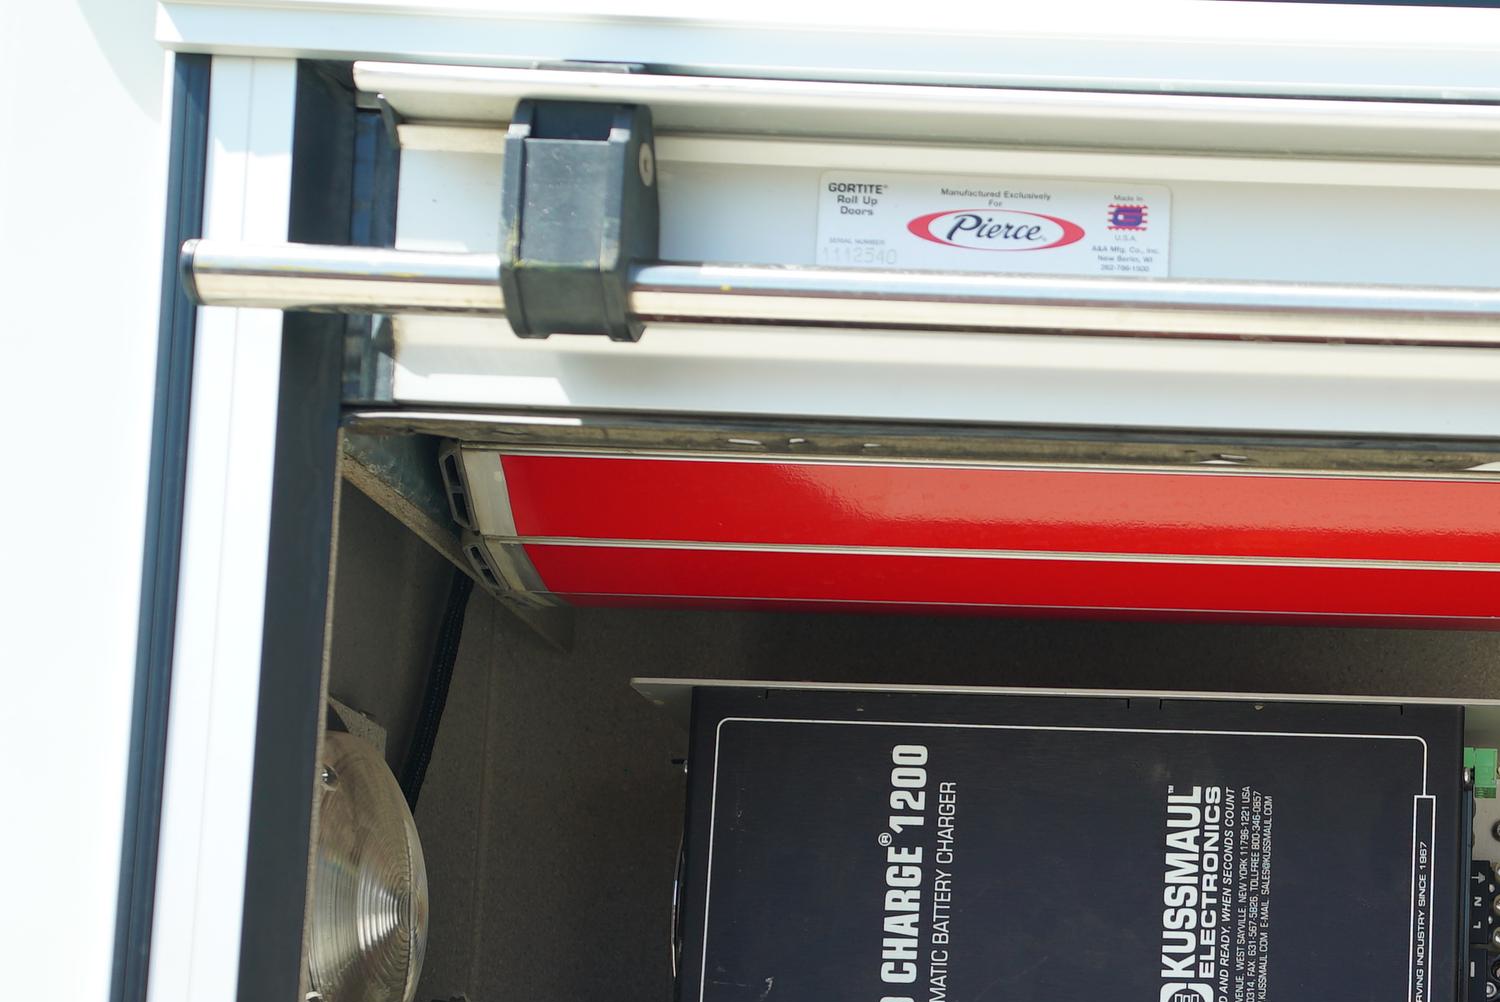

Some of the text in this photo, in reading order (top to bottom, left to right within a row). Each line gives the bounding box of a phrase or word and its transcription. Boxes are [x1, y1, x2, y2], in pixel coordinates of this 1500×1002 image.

[837, 194, 878, 207] Roll Up
[840, 205, 874, 216] Doors
[941, 188, 1051, 201] Manufactured Exclusively
[988, 199, 1002, 207] For
[946, 213, 1042, 241] Pierce
[889, 743, 929, 833] 1200
[1241, 786, 1250, 803] USA
[935, 781, 957, 864] CHARGER
[1225, 786, 1235, 827] COUNT
[1252, 790, 1262, 850] 800-346-0857
[1240, 806, 1250, 855] 11796-1221
[1262, 796, 1273, 895] SALES@KUSSMAUL.COM
[1222, 830, 1233, 885] SECONDS
[1239, 858, 1248, 880] YORK
[1250, 852, 1260, 892] TOLLFREE
[1199, 786, 1221, 978] ELECTRONICS
[1238, 882, 1248, 902] NEW
[1417, 874, 1428, 906] SINCE
[931, 868, 952, 944] BATTERY
[1222, 887, 1232, 922] WHEN
[1416, 910, 1427, 966] INDUSTRY
[1236, 946, 1246, 970] WEST
[1218, 969, 1229, 993] AND
